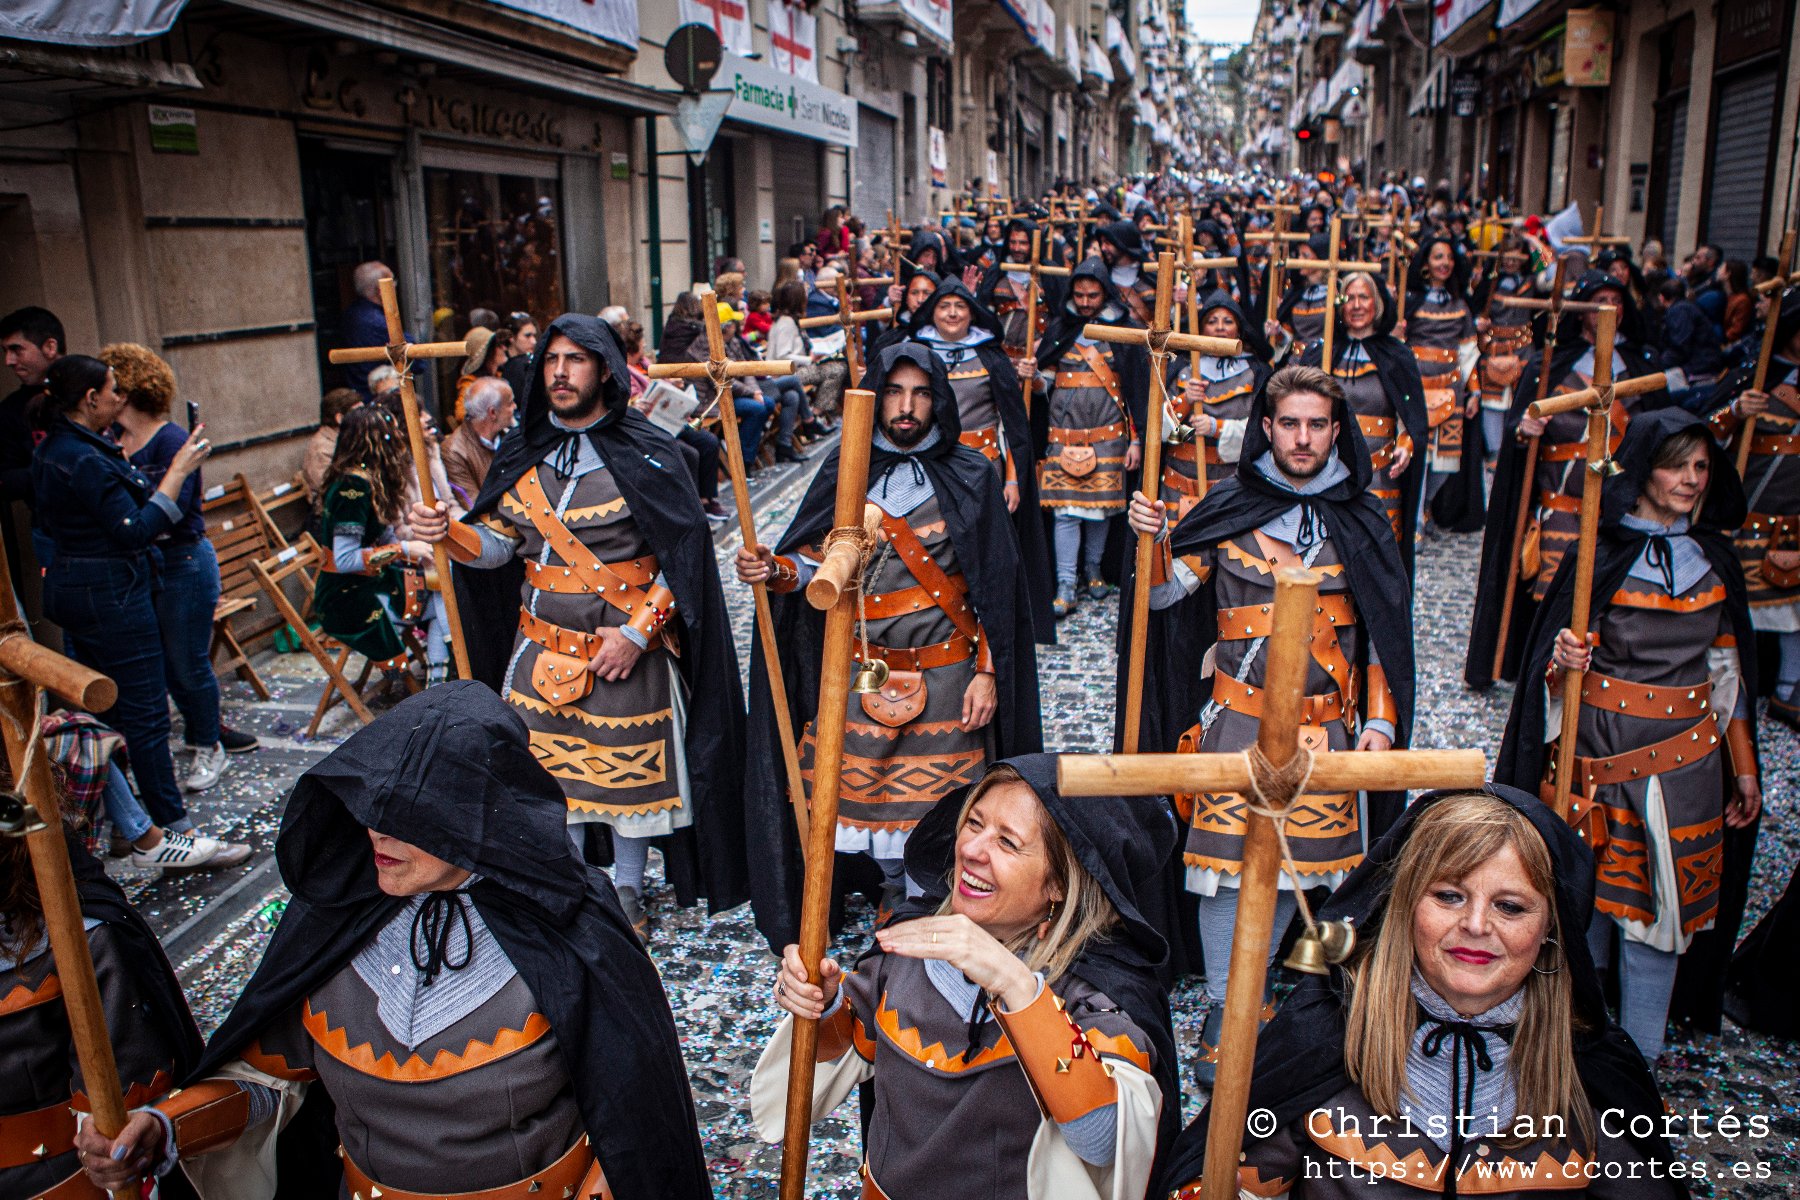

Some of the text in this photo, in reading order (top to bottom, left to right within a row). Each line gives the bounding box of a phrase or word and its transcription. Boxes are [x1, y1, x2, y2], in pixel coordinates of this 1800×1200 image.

[735, 73, 850, 131] Farmacia Sant Nicolau
